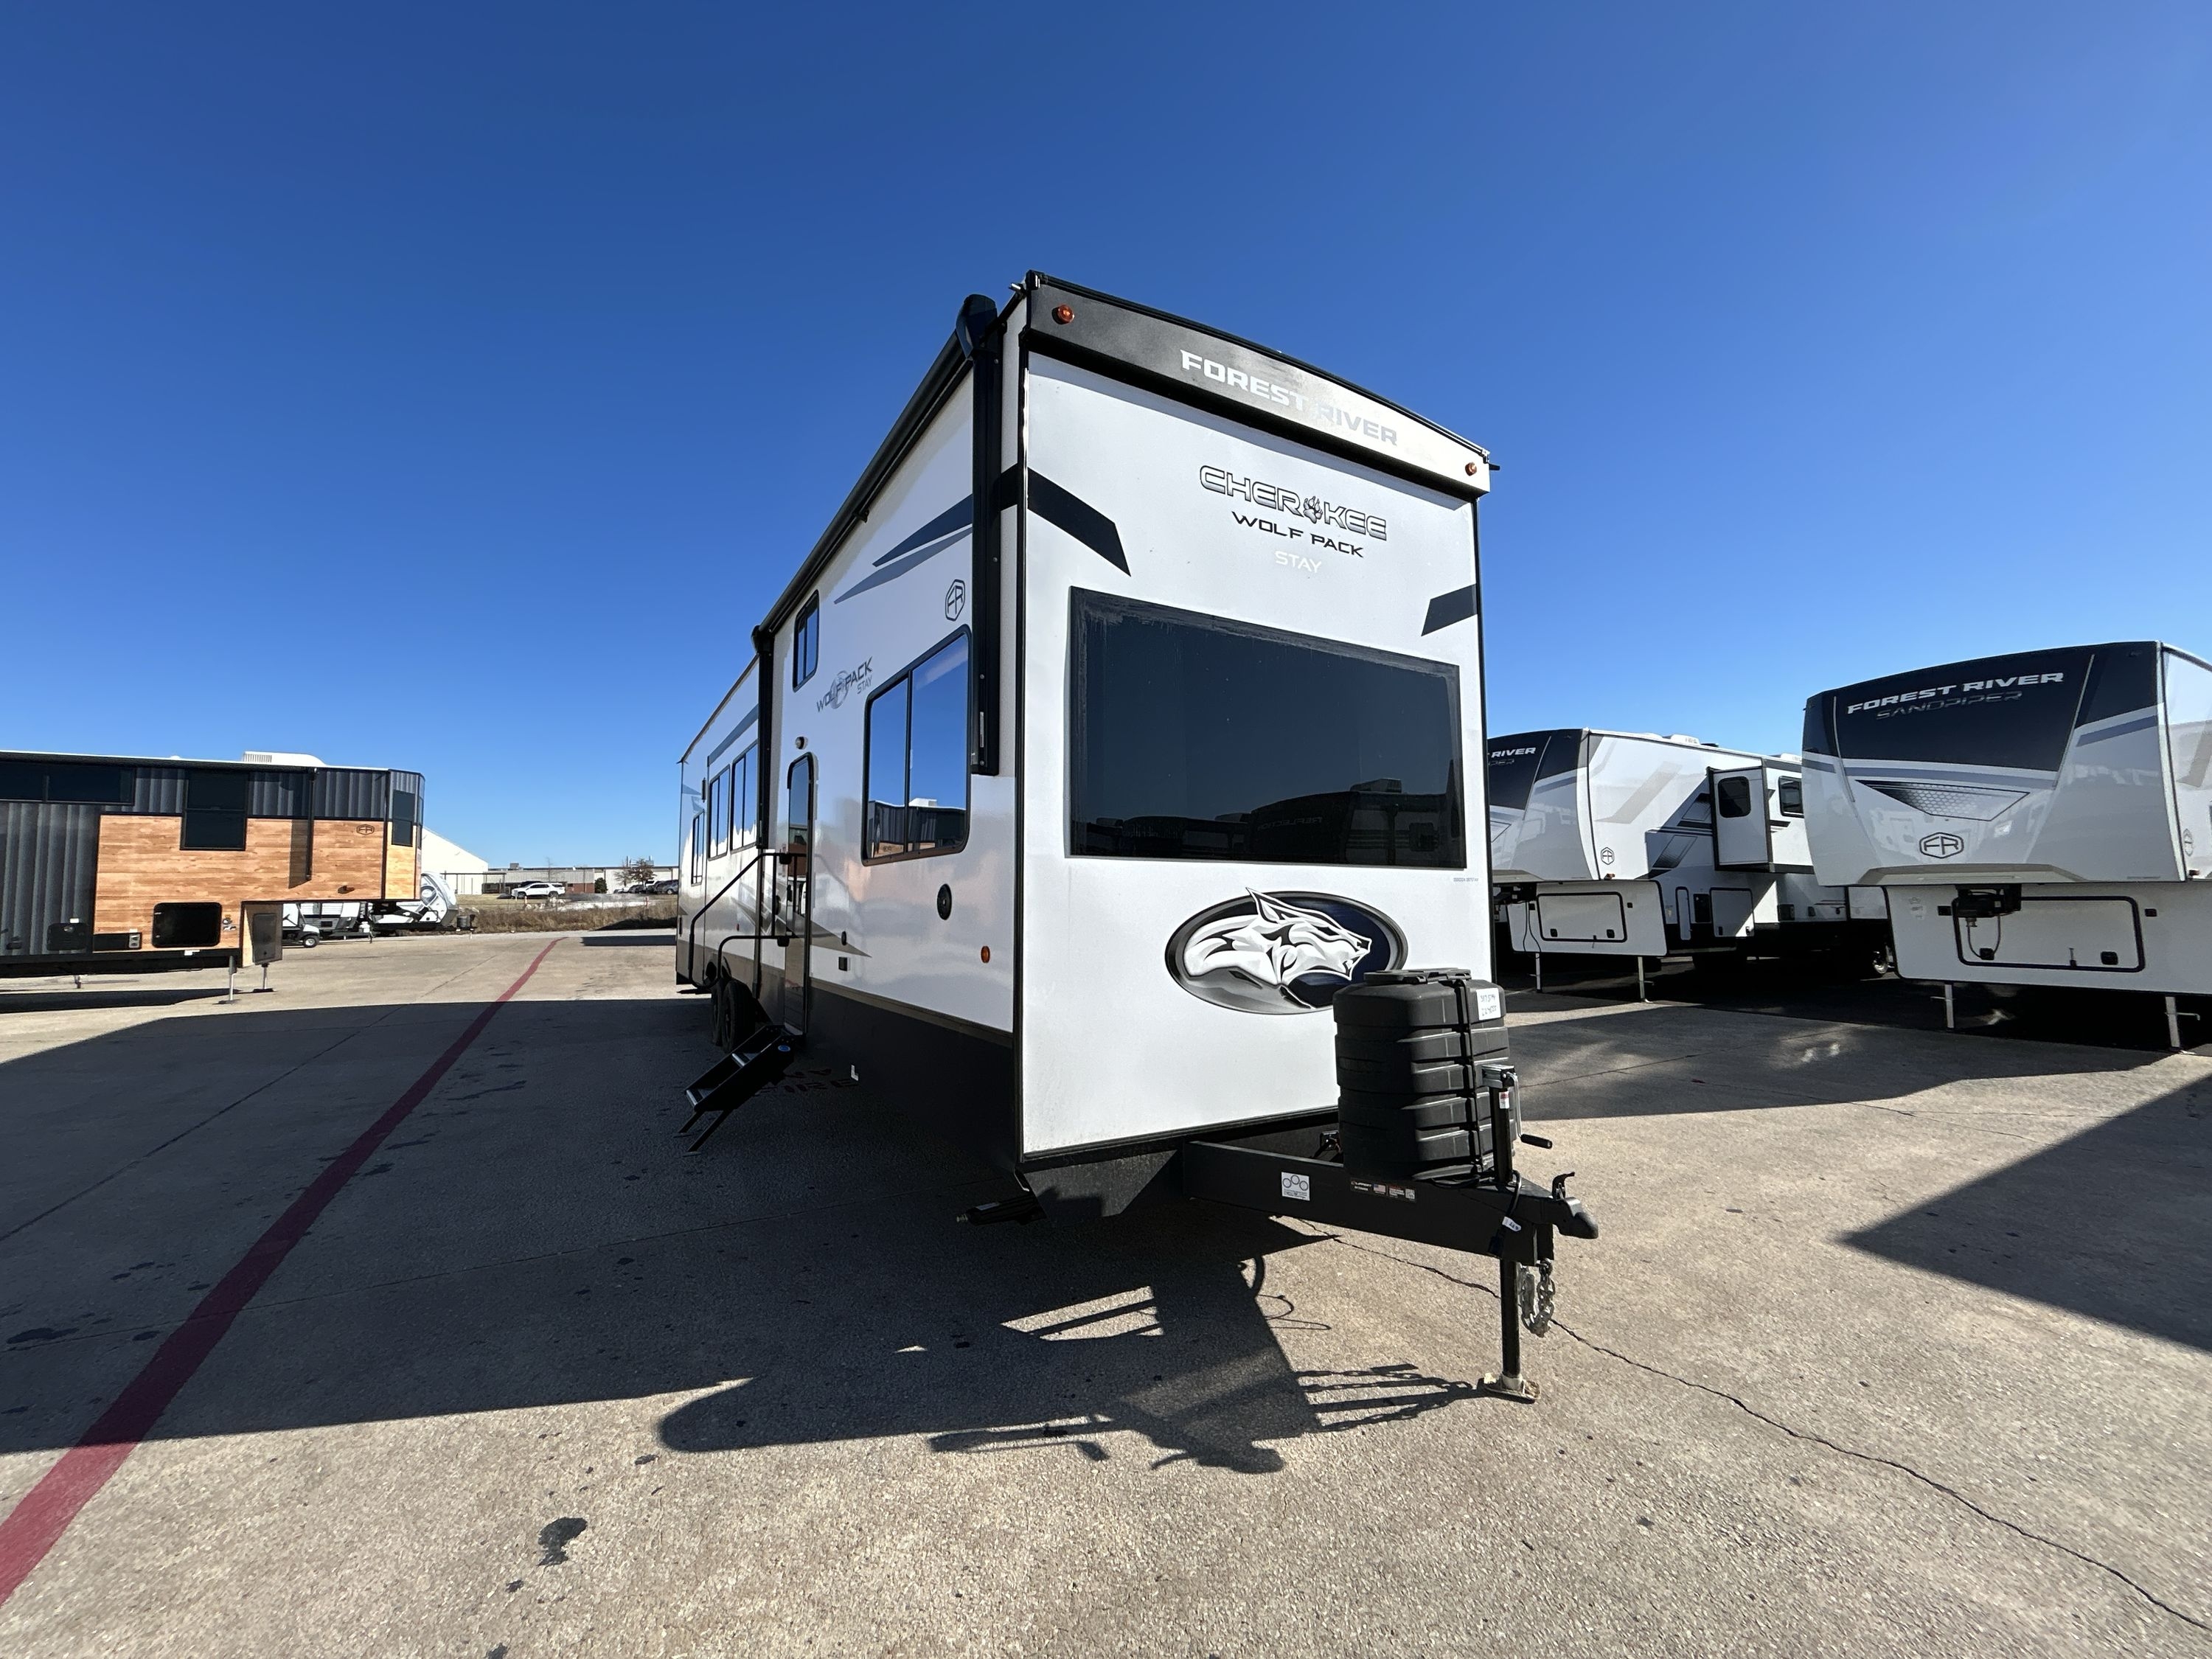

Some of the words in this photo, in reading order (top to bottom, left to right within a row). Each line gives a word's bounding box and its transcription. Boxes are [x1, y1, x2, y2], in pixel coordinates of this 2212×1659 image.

[1180, 349, 1309, 411] FOREST
[1310, 400, 1399, 447] RIVER
[1231, 510, 1304, 539] WOLF
[1310, 532, 1365, 558] PACK
[1274, 550, 1322, 573] STAY
[816, 681, 844, 713] WOLF
[844, 655, 873, 692] PACK
[856, 675, 873, 695] STAY
[1847, 685, 1958, 714] FOREST
[1963, 672, 2065, 692] RIVER
[1876, 690, 2023, 720] SANDPIPER
[1491, 747, 1536, 758] RIVER
